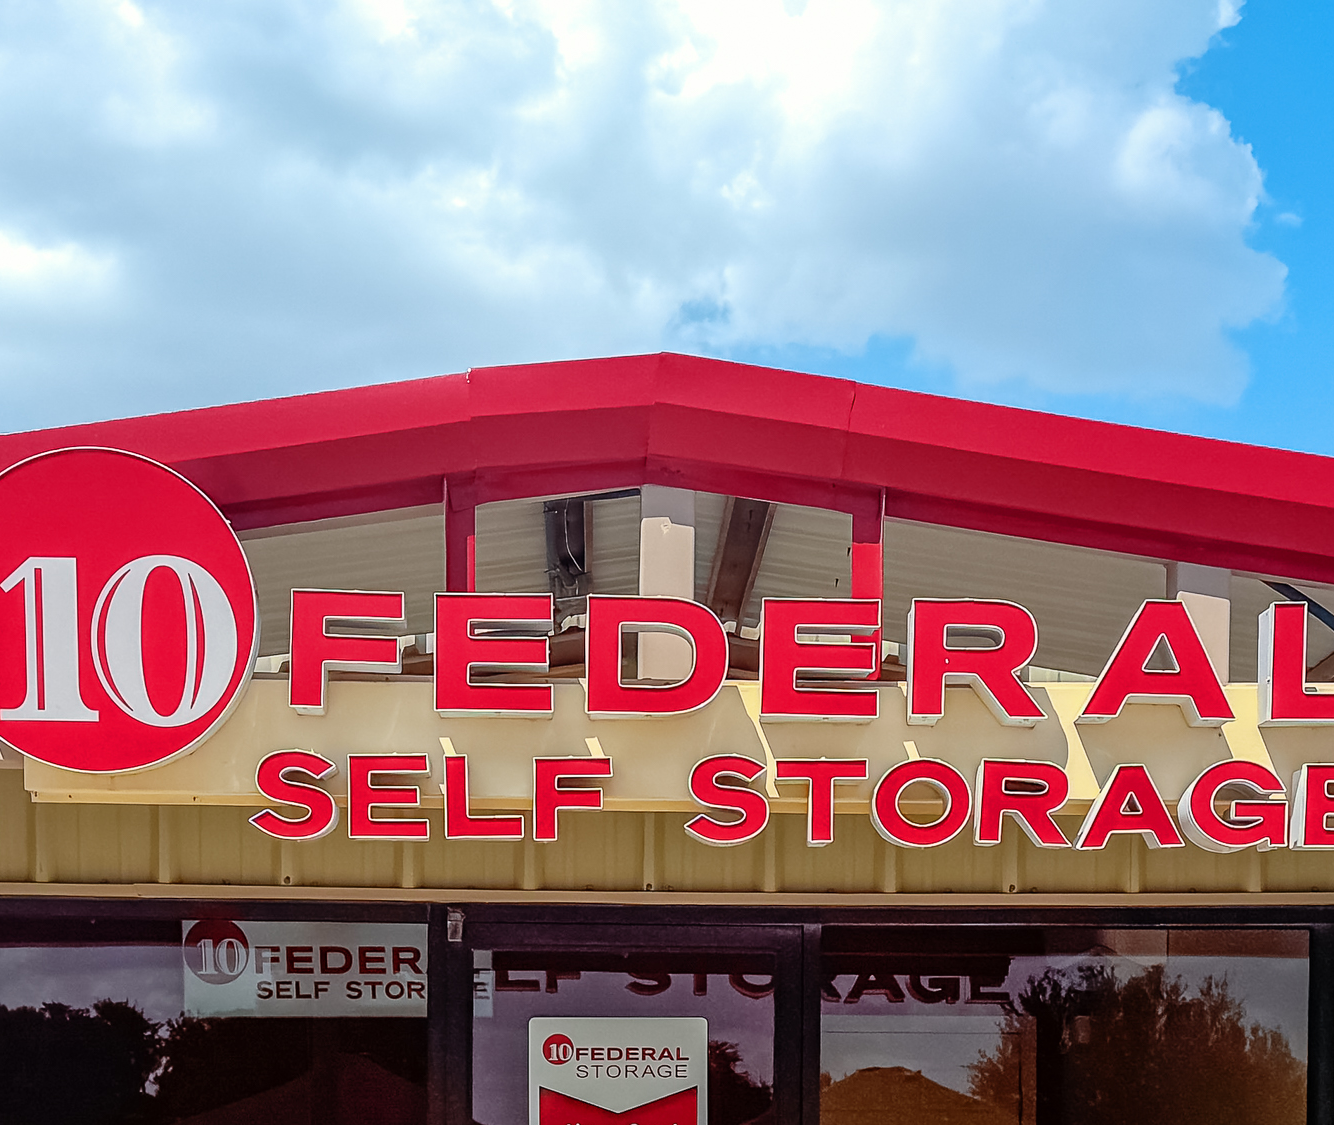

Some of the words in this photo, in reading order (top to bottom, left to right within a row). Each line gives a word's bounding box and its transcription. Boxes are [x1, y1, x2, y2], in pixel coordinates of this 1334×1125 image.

[248, 748, 614, 842] SELF
[196, 938, 248, 975] 10
[254, 945, 425, 975] FEDER
[256, 980, 331, 1000] SELF
[345, 980, 426, 1000] STOR
[548, 1043, 573, 1061] 10
[574, 1046, 690, 1062] FEDERAL
[575, 1064, 688, 1079] STORAGE
